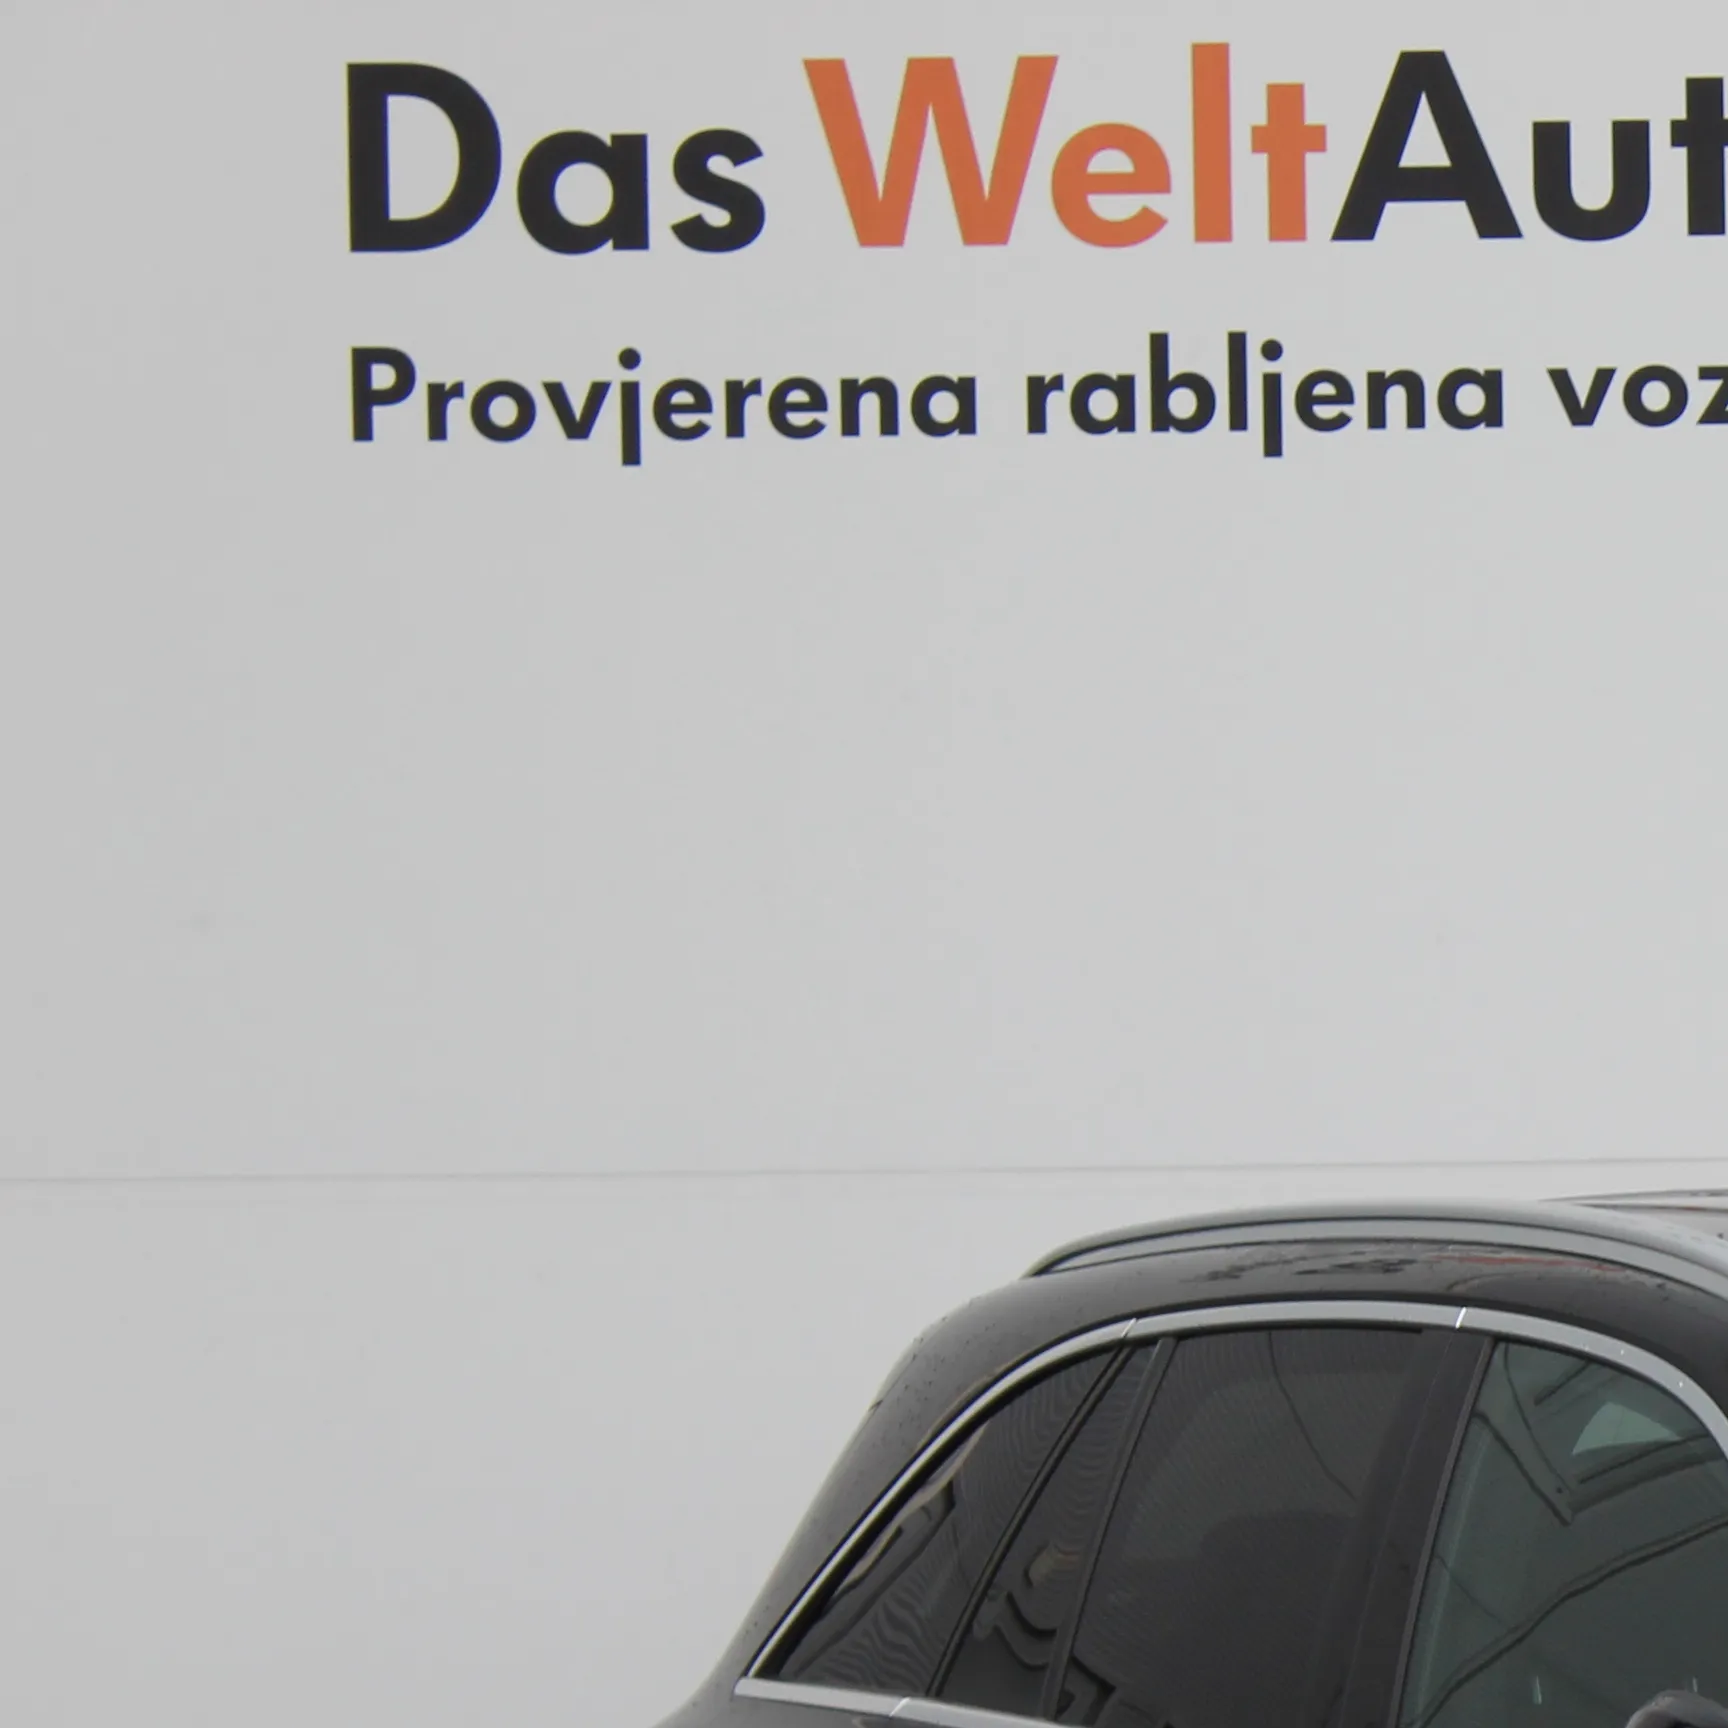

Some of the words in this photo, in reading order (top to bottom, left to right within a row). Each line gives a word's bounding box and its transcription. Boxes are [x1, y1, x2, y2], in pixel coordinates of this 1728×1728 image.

[344, 60, 767, 257] Das
[349, 344, 978, 468] Provjerena
[1025, 329, 1505, 459] rabljena
